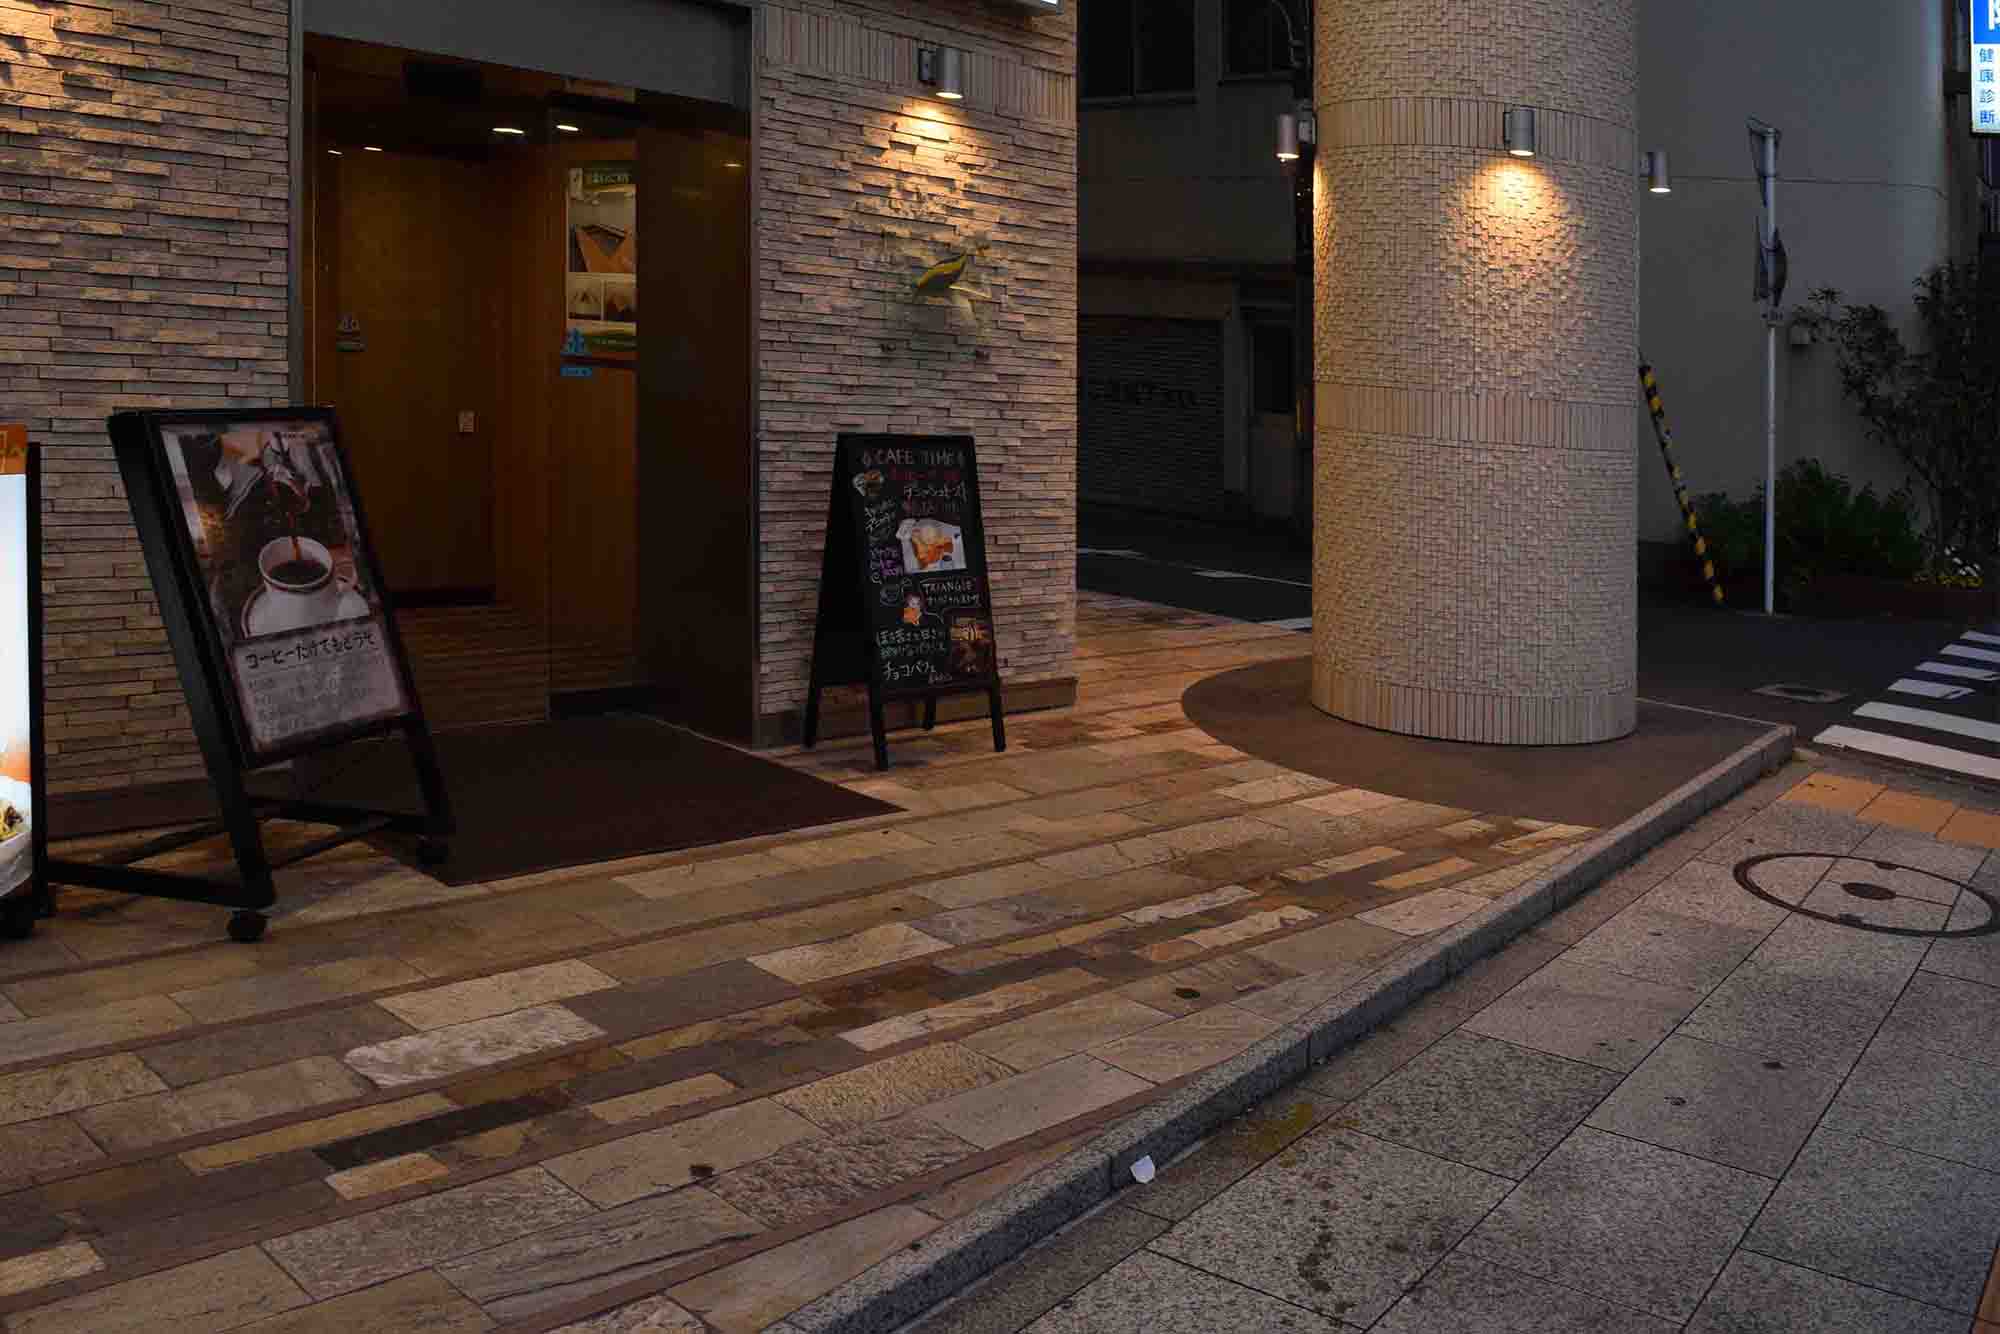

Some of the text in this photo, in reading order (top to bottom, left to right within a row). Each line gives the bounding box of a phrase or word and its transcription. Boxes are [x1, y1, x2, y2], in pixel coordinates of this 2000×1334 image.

[1979, 47, 1995, 125] 健康診断
[874, 447, 914, 465] CAFE
